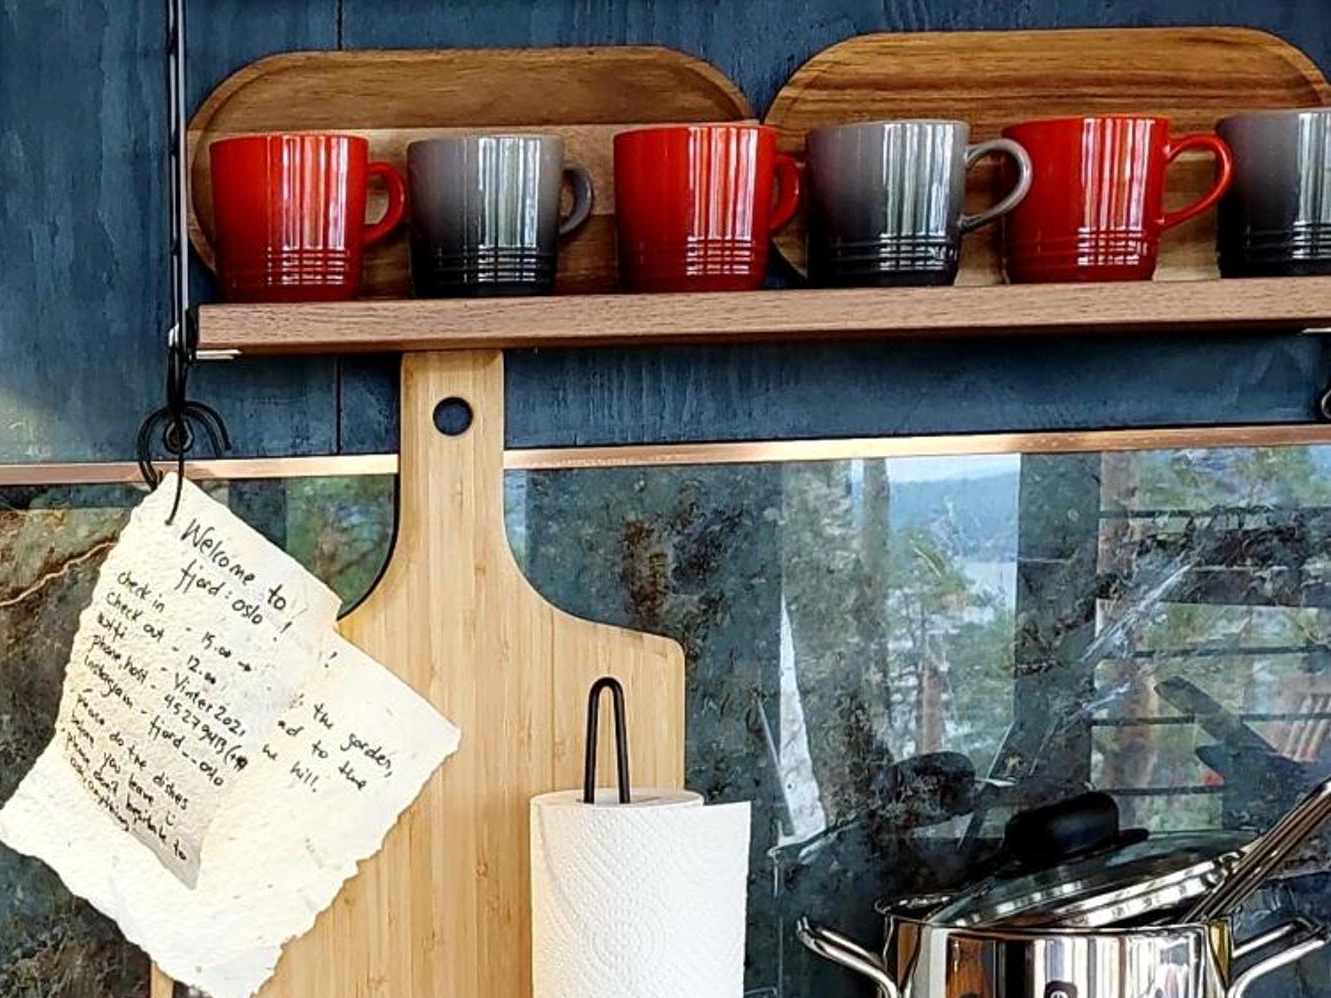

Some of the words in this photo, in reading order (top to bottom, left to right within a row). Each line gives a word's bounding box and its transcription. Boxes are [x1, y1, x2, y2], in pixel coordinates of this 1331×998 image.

[179, 517, 256, 587] Welcome
[267, 583, 288, 612] to
[151, 594, 166, 614] in
[142, 623, 166, 642] out
[313, 703, 335, 730] the
[311, 740, 329, 759] to
[108, 731, 125, 747] do
[127, 744, 147, 772] the
[152, 772, 190, 811] dishes
